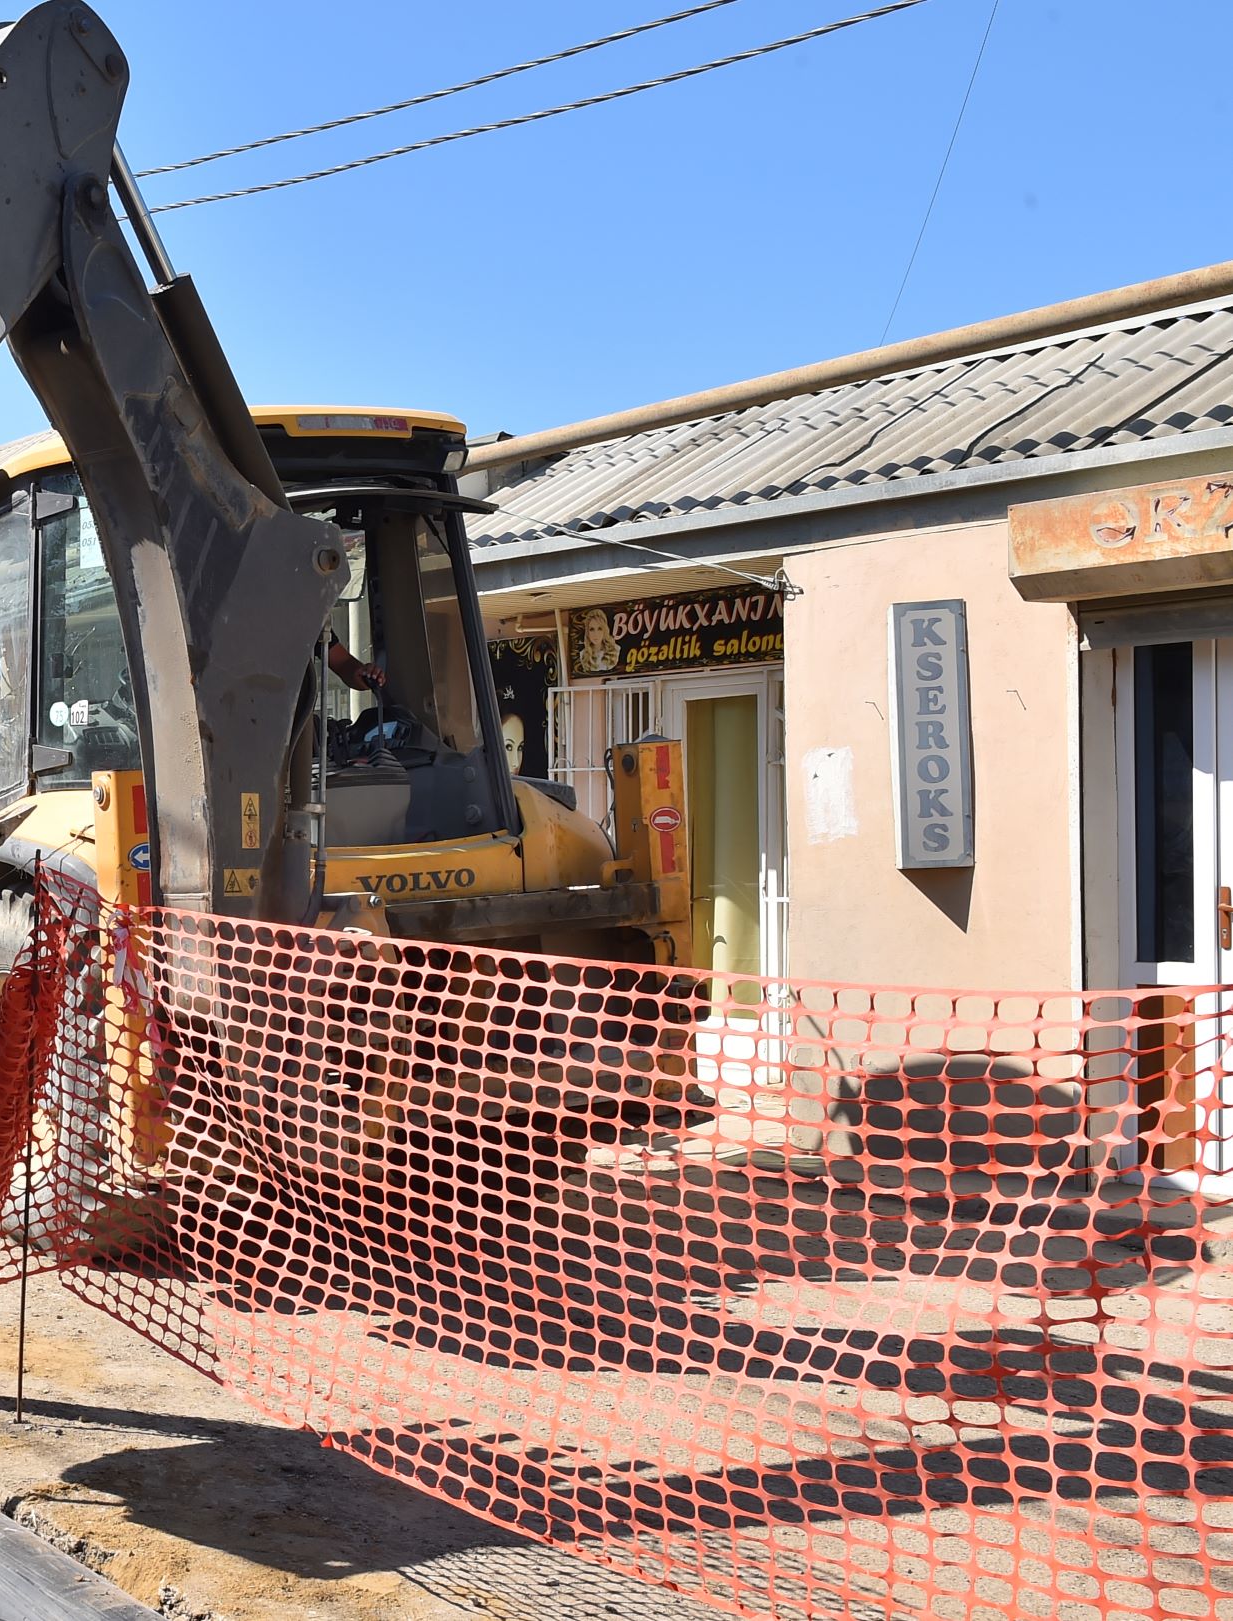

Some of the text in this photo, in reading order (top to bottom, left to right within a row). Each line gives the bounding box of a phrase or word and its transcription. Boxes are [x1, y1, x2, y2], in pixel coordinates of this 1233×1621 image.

[71, 710, 87, 724] 102
[910, 617, 954, 853] KSEROKS
[355, 868, 476, 893] VOLVO
